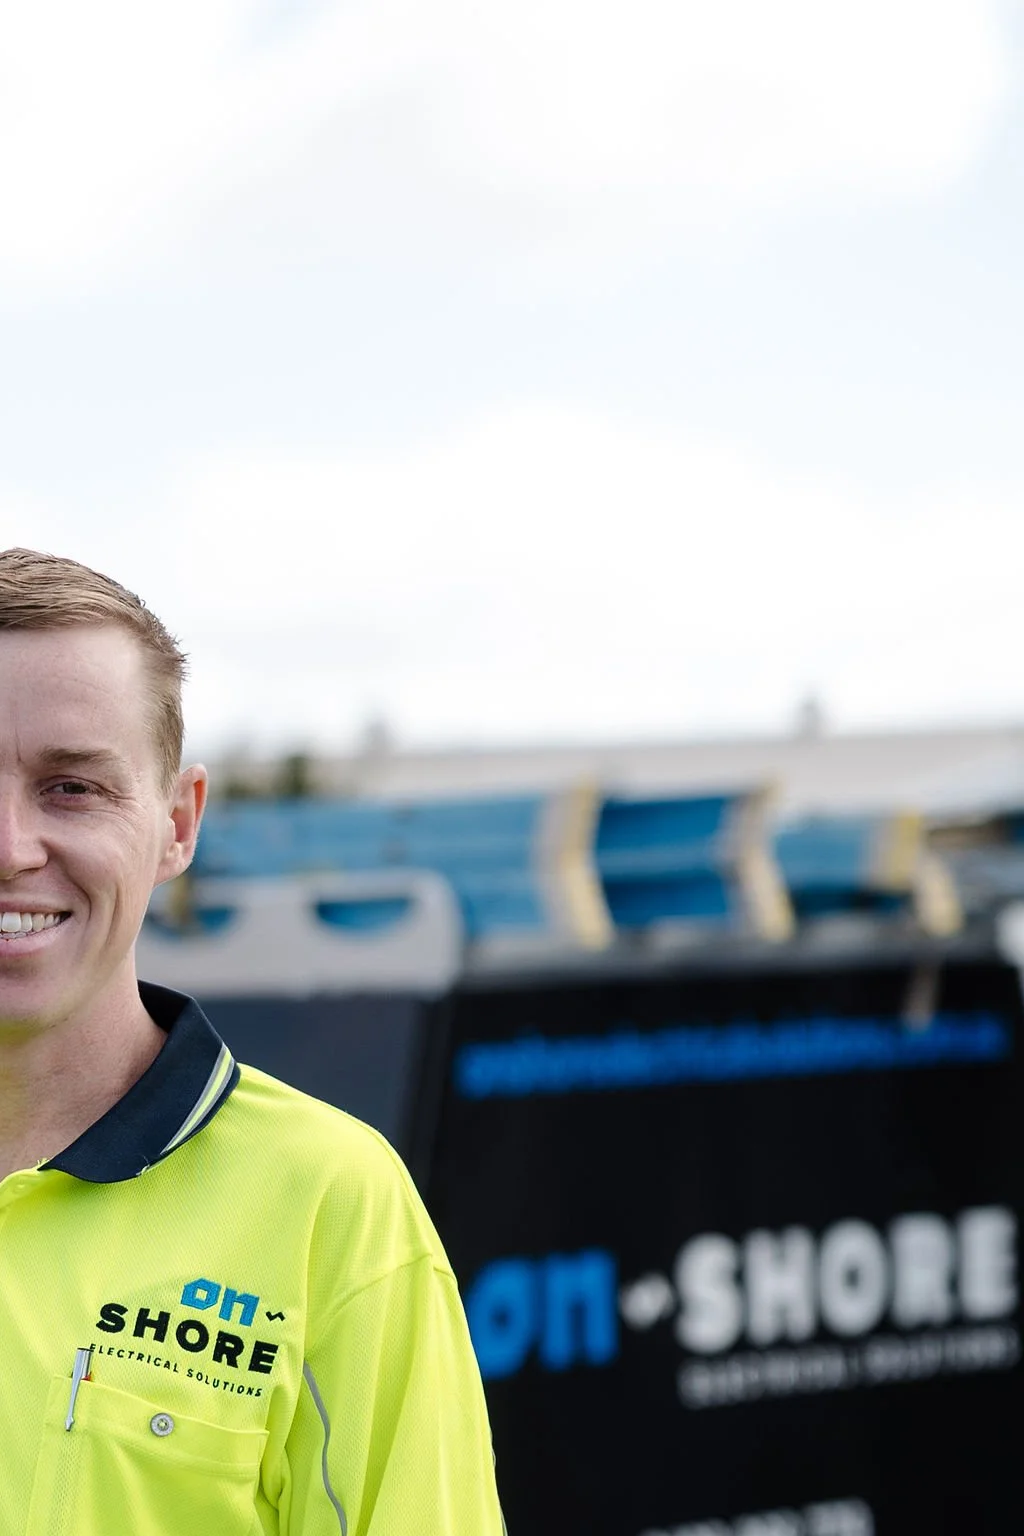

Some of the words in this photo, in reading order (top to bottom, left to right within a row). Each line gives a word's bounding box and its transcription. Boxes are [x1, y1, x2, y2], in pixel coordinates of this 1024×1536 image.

[677, 1207, 1017, 1353] SHORE
[89, 1343, 179, 1373] ELECTRICAL
[186, 1368, 263, 1397] SOLUTIONS
[95, 1302, 279, 1375] SHORE
